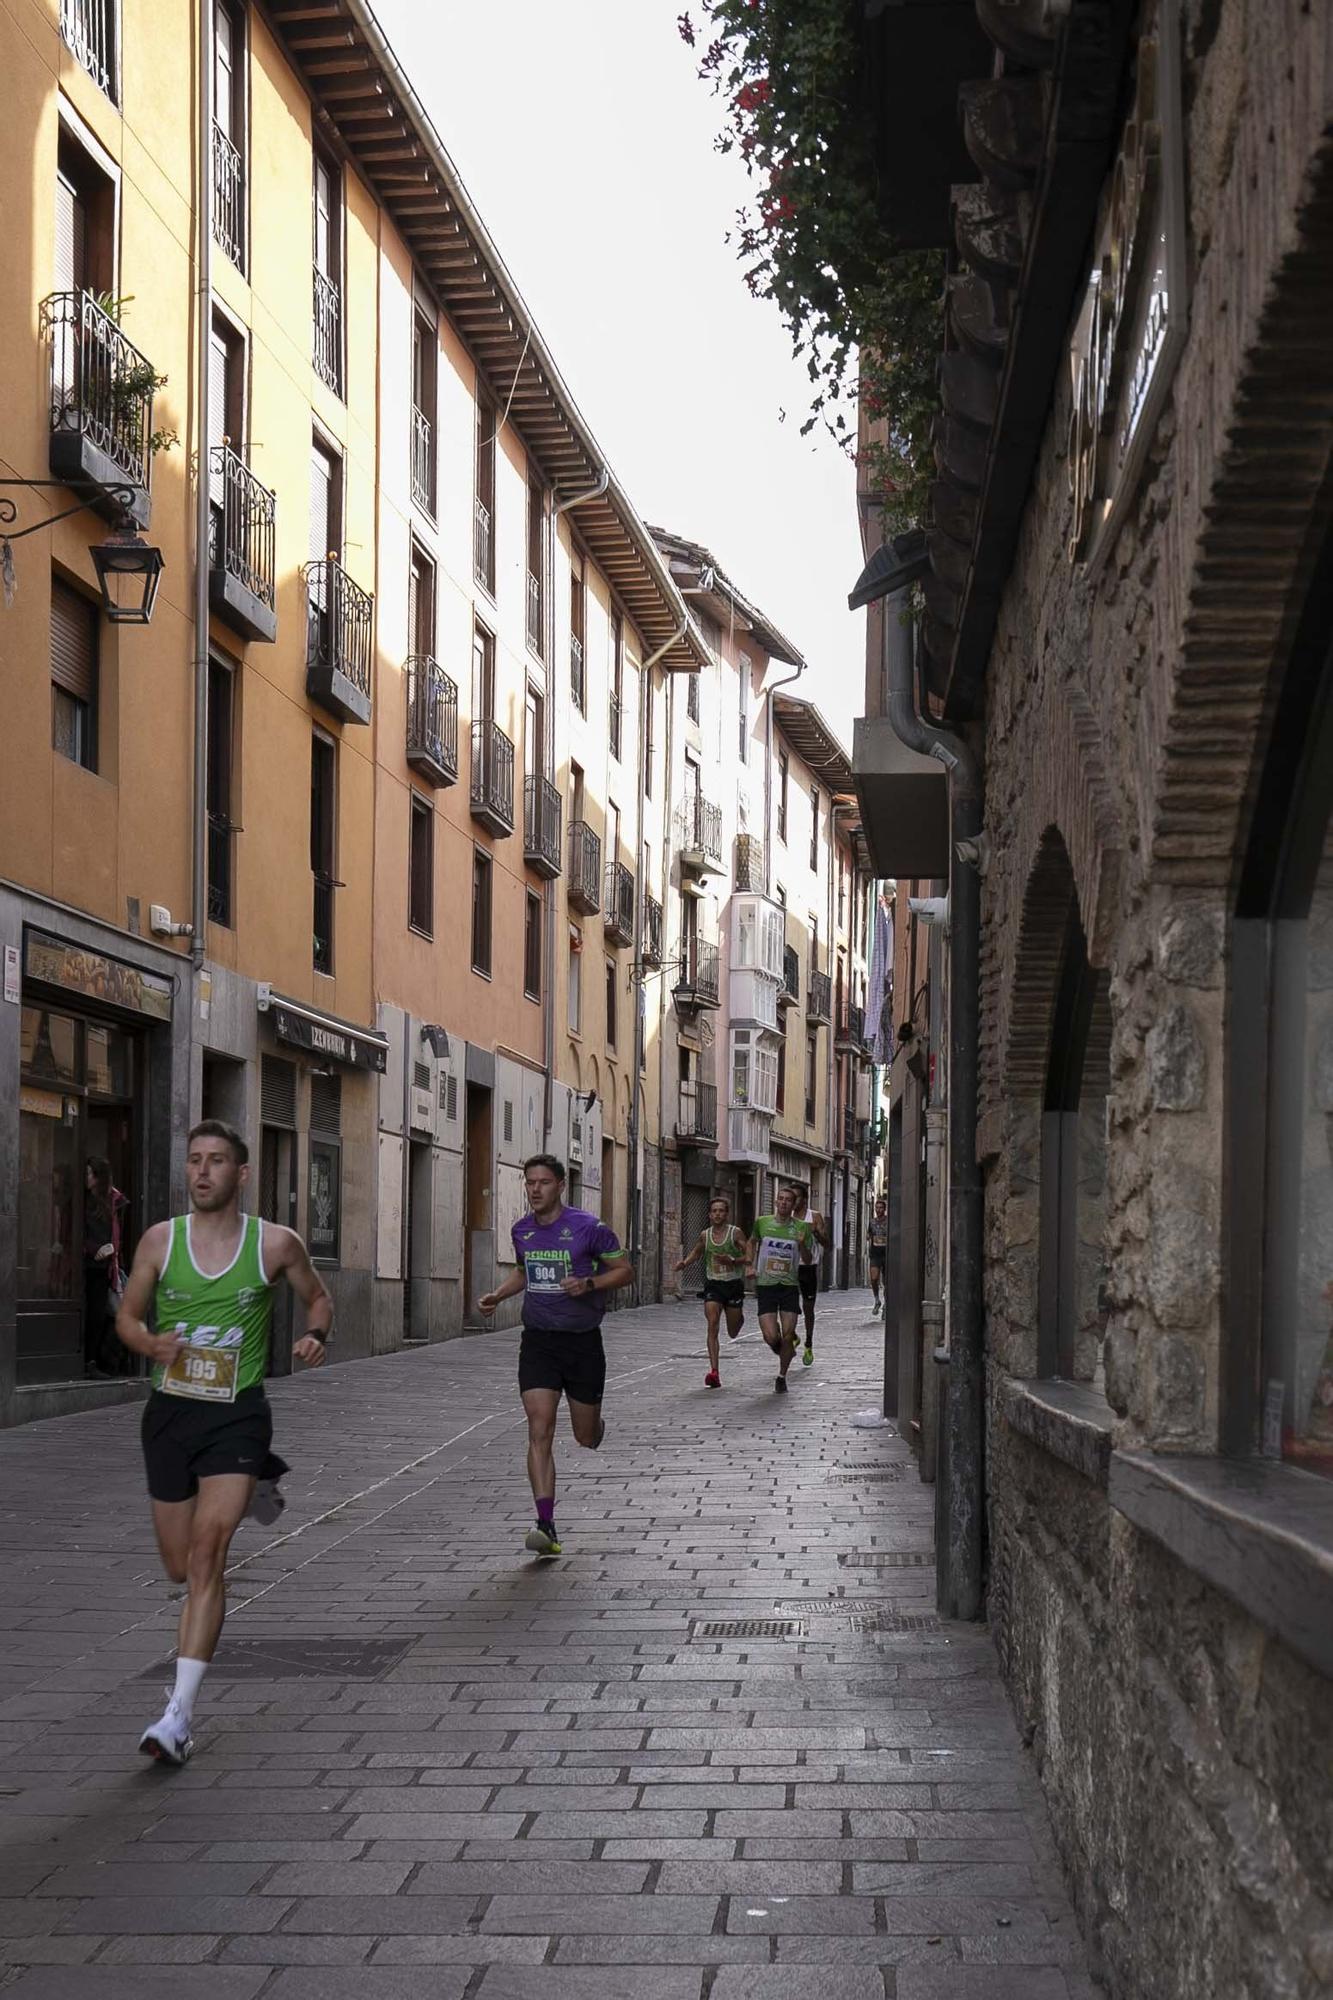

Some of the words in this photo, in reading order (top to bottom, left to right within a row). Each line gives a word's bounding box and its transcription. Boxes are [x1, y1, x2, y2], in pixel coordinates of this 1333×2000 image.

[768, 1240, 793, 1250] LEA
[534, 1267, 556, 1280] 904
[184, 1357, 217, 1381] 195
